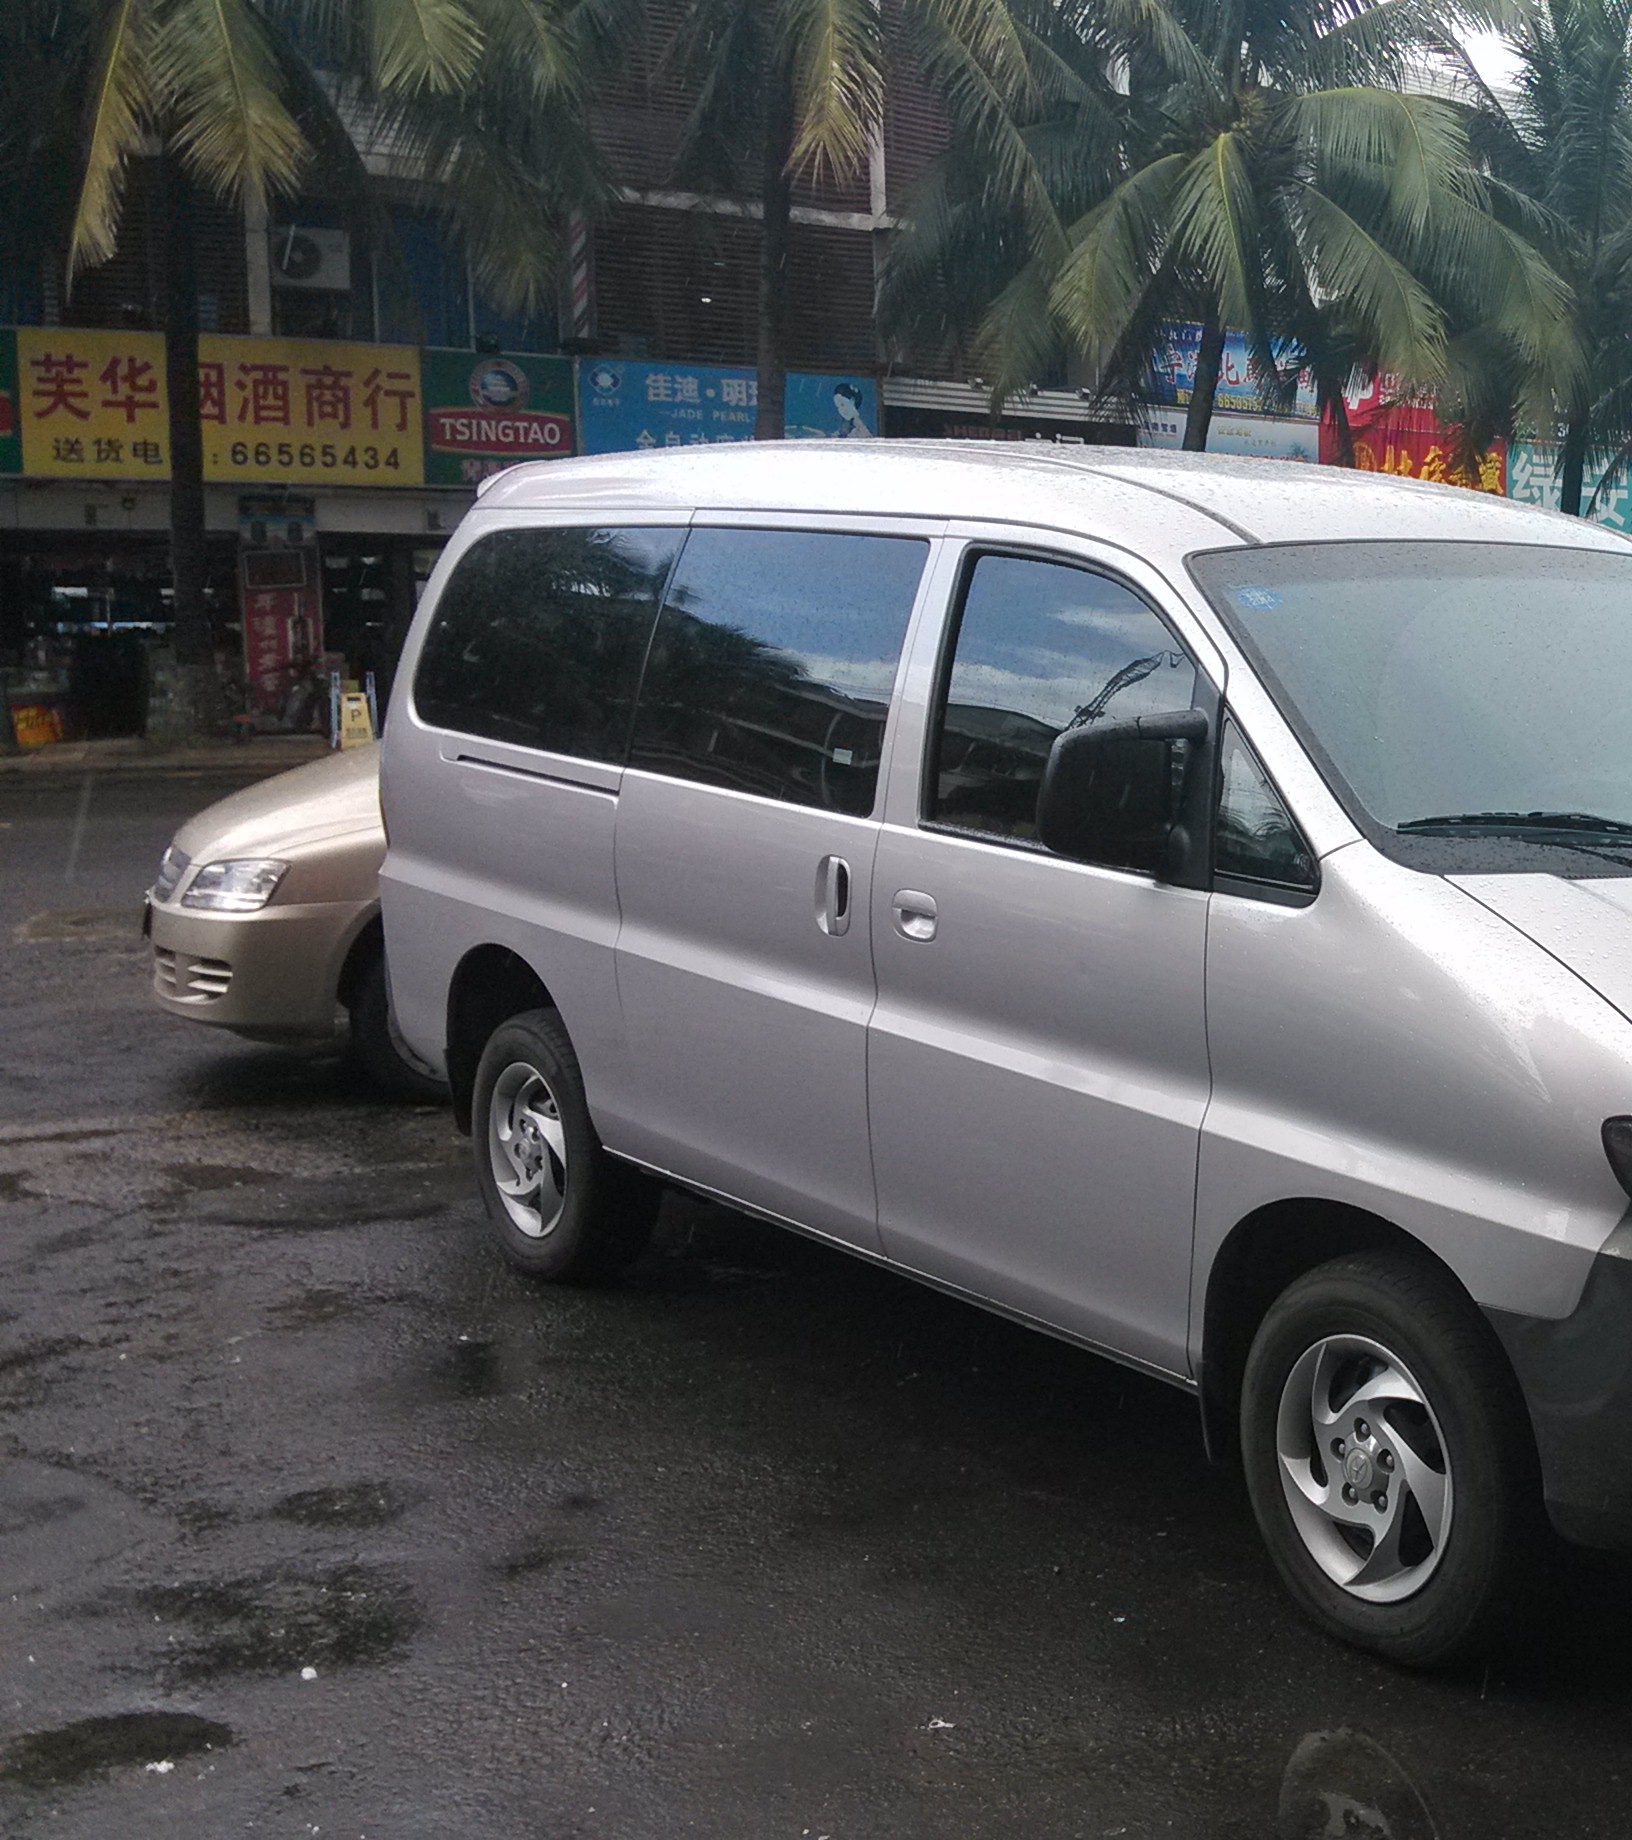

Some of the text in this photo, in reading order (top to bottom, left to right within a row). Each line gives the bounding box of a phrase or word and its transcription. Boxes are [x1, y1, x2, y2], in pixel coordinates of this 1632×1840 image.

[671, 408, 751, 423] JADE PEARL
[439, 417, 561, 446] TSINGTAO
[350, 709, 361, 721] P
